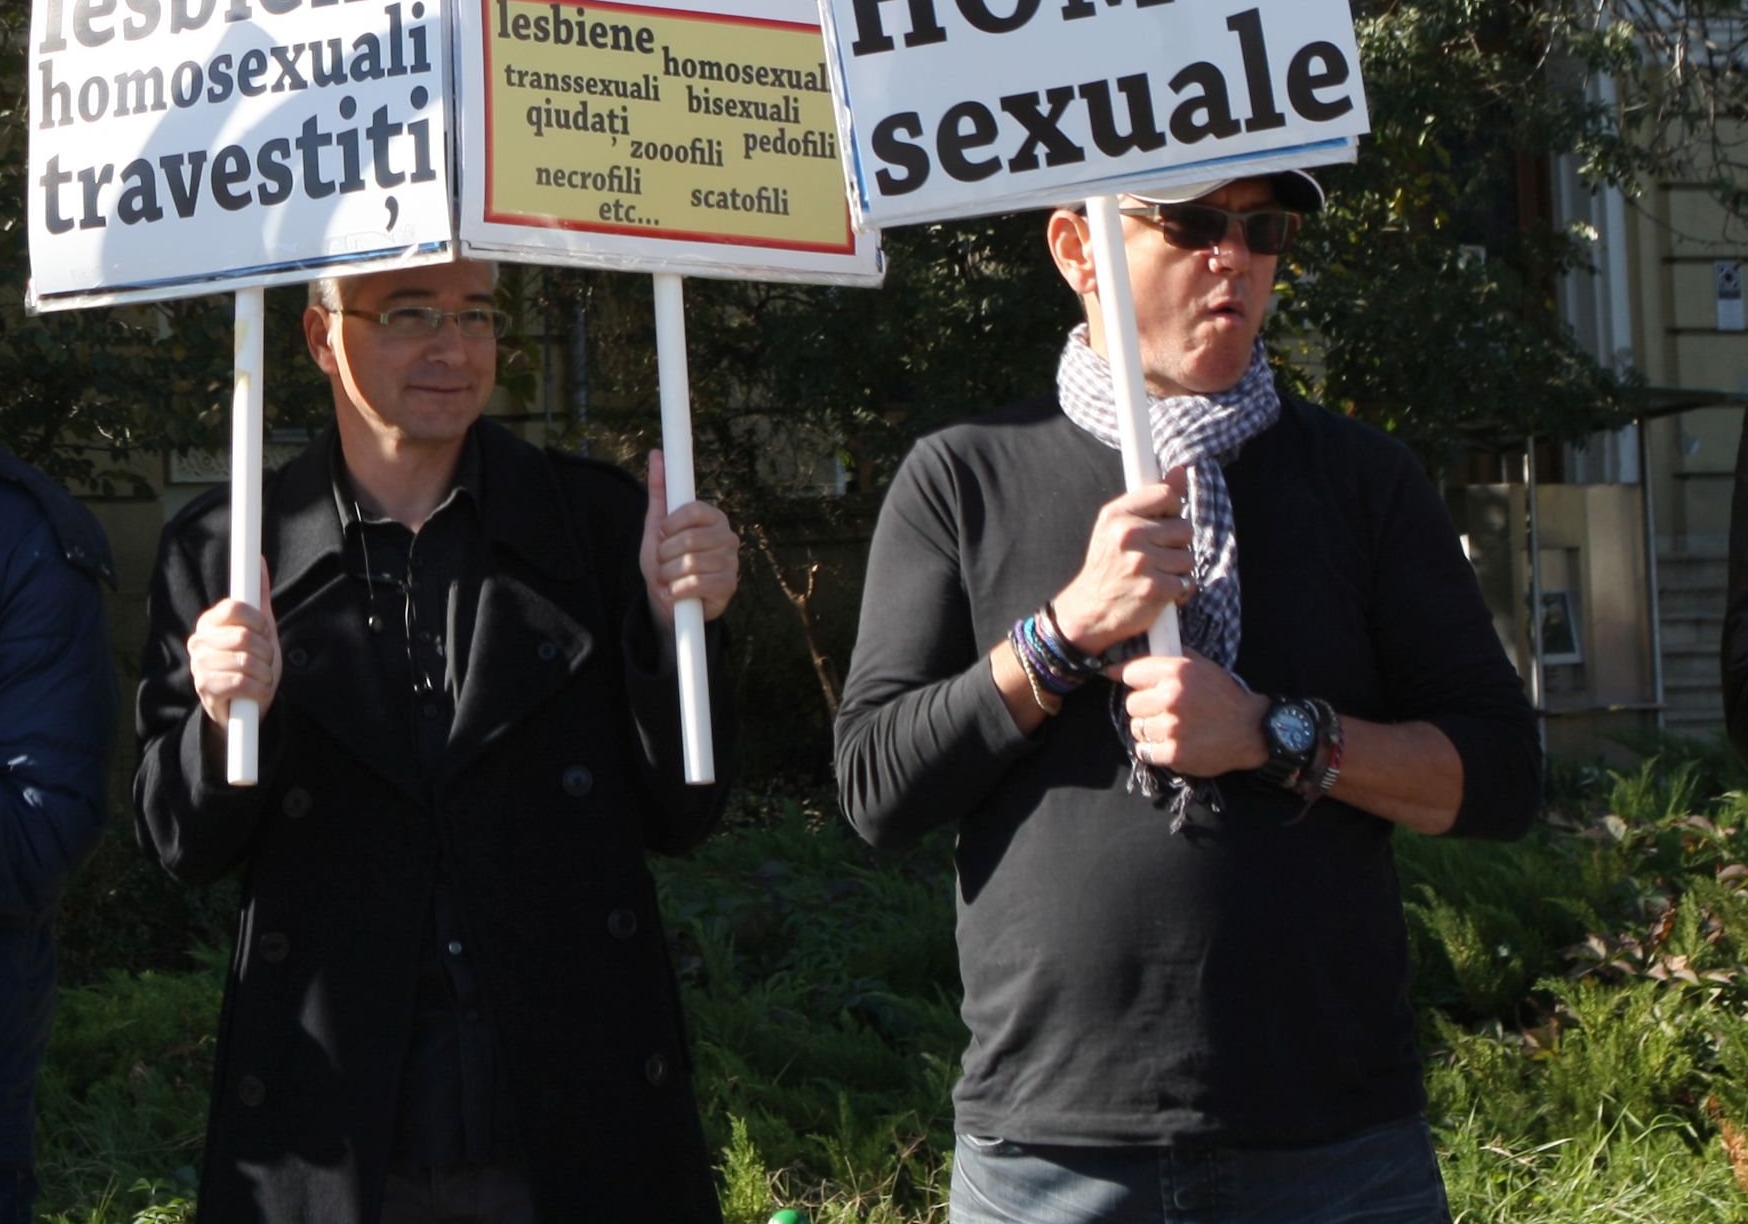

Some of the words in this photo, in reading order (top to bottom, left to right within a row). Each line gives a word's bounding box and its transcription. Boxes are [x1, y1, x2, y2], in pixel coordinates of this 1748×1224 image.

[39, 4, 431, 131] homosexuali
[504, 64, 660, 102] transsexuali
[662, 46, 830, 93] homosexual
[686, 85, 801, 124] bisexuali
[870, 7, 1353, 198] sexuale
[526, 98, 629, 147] qiudați
[40, 87, 437, 235] travestiți
[630, 137, 724, 168] zooofili
[743, 128, 836, 159] pedofili
[535, 165, 642, 195] necrofili
[599, 199, 659, 225] etc...
[691, 186, 789, 216] scatofili
